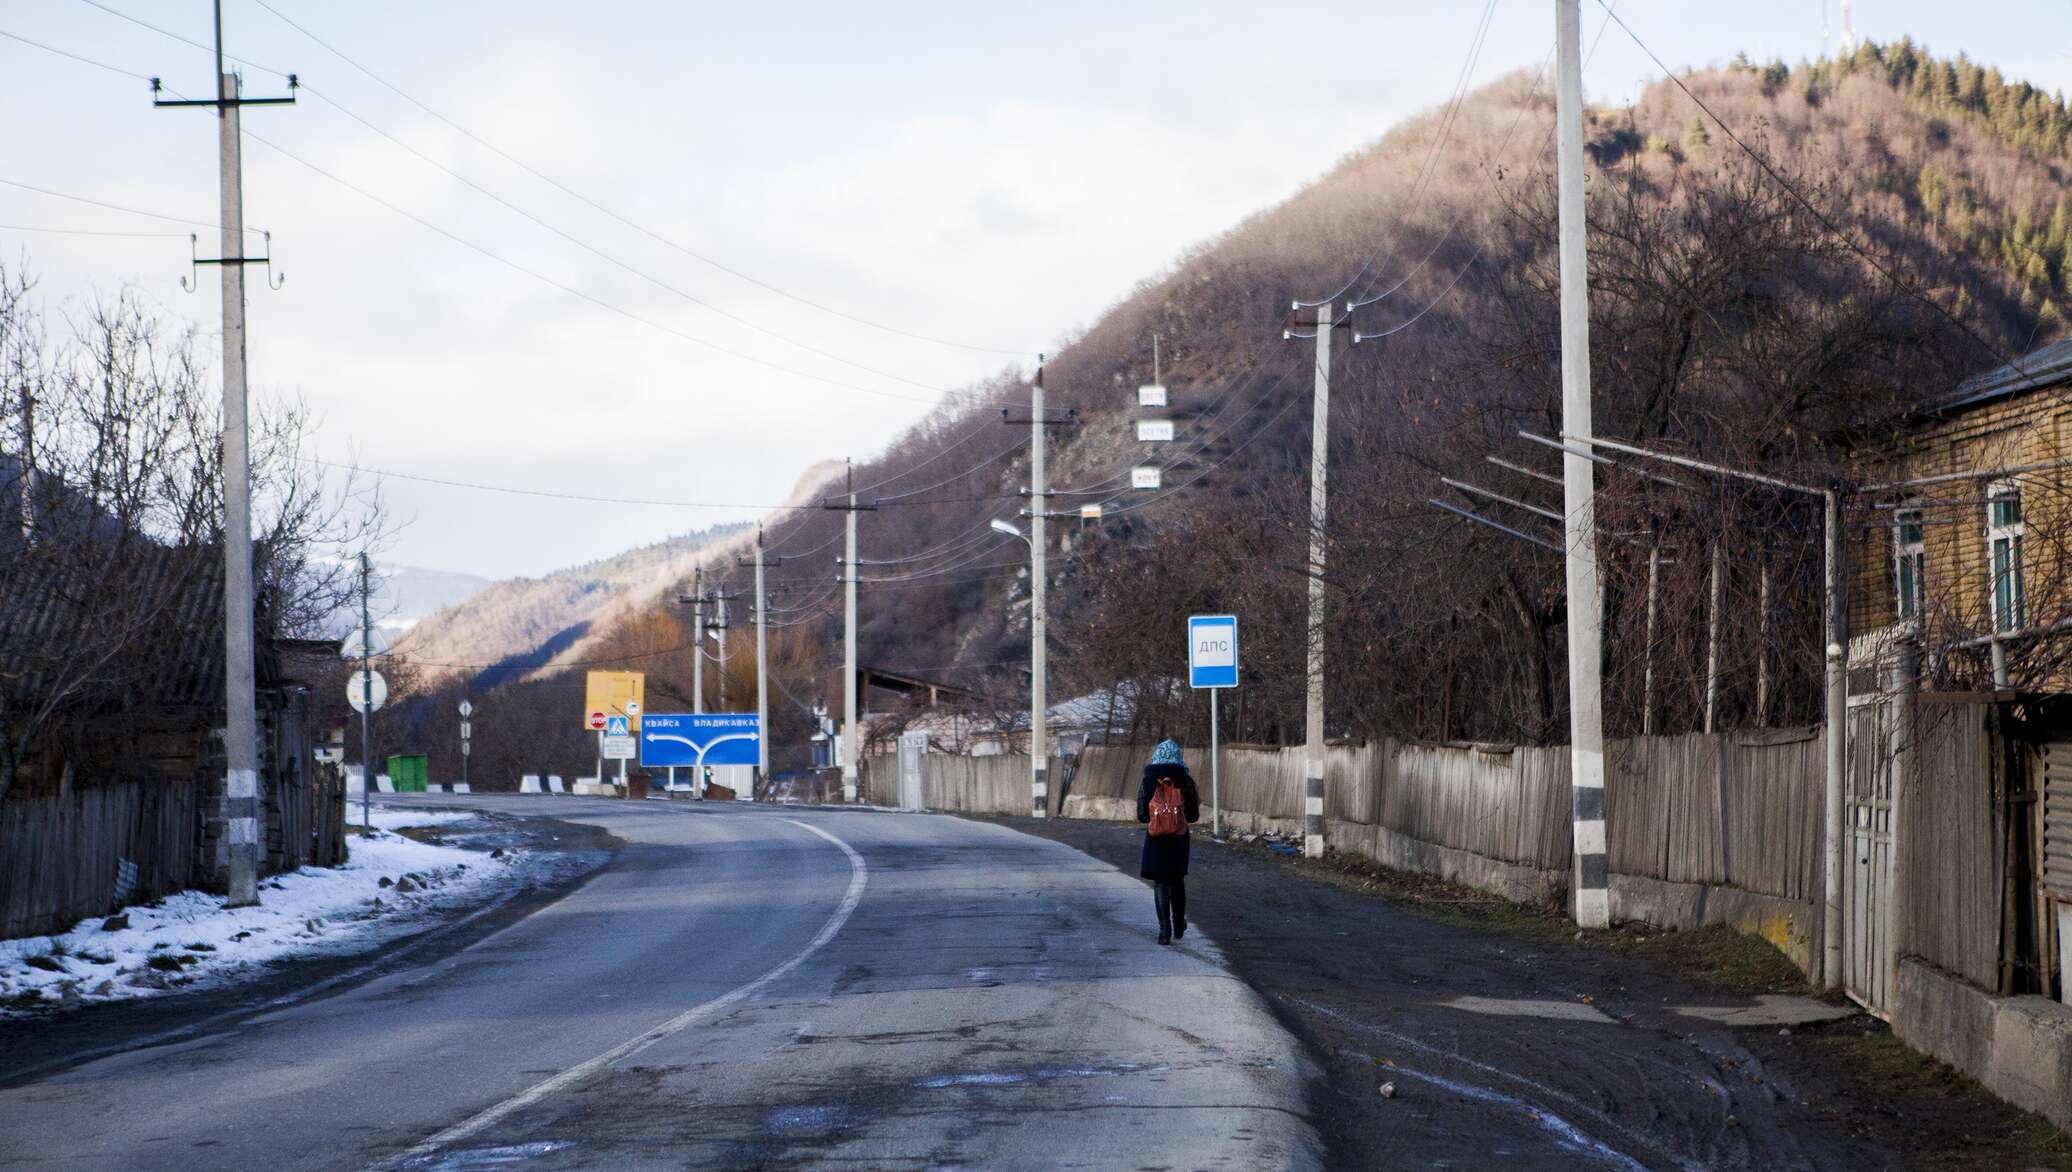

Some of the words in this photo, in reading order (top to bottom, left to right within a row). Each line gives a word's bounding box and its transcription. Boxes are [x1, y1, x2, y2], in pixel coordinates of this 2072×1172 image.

[1200, 640, 1228, 652] ДПС
[645, 719, 680, 728] КВАЙСА
[694, 719, 760, 728] ВЛАДИКАВКАЗ
